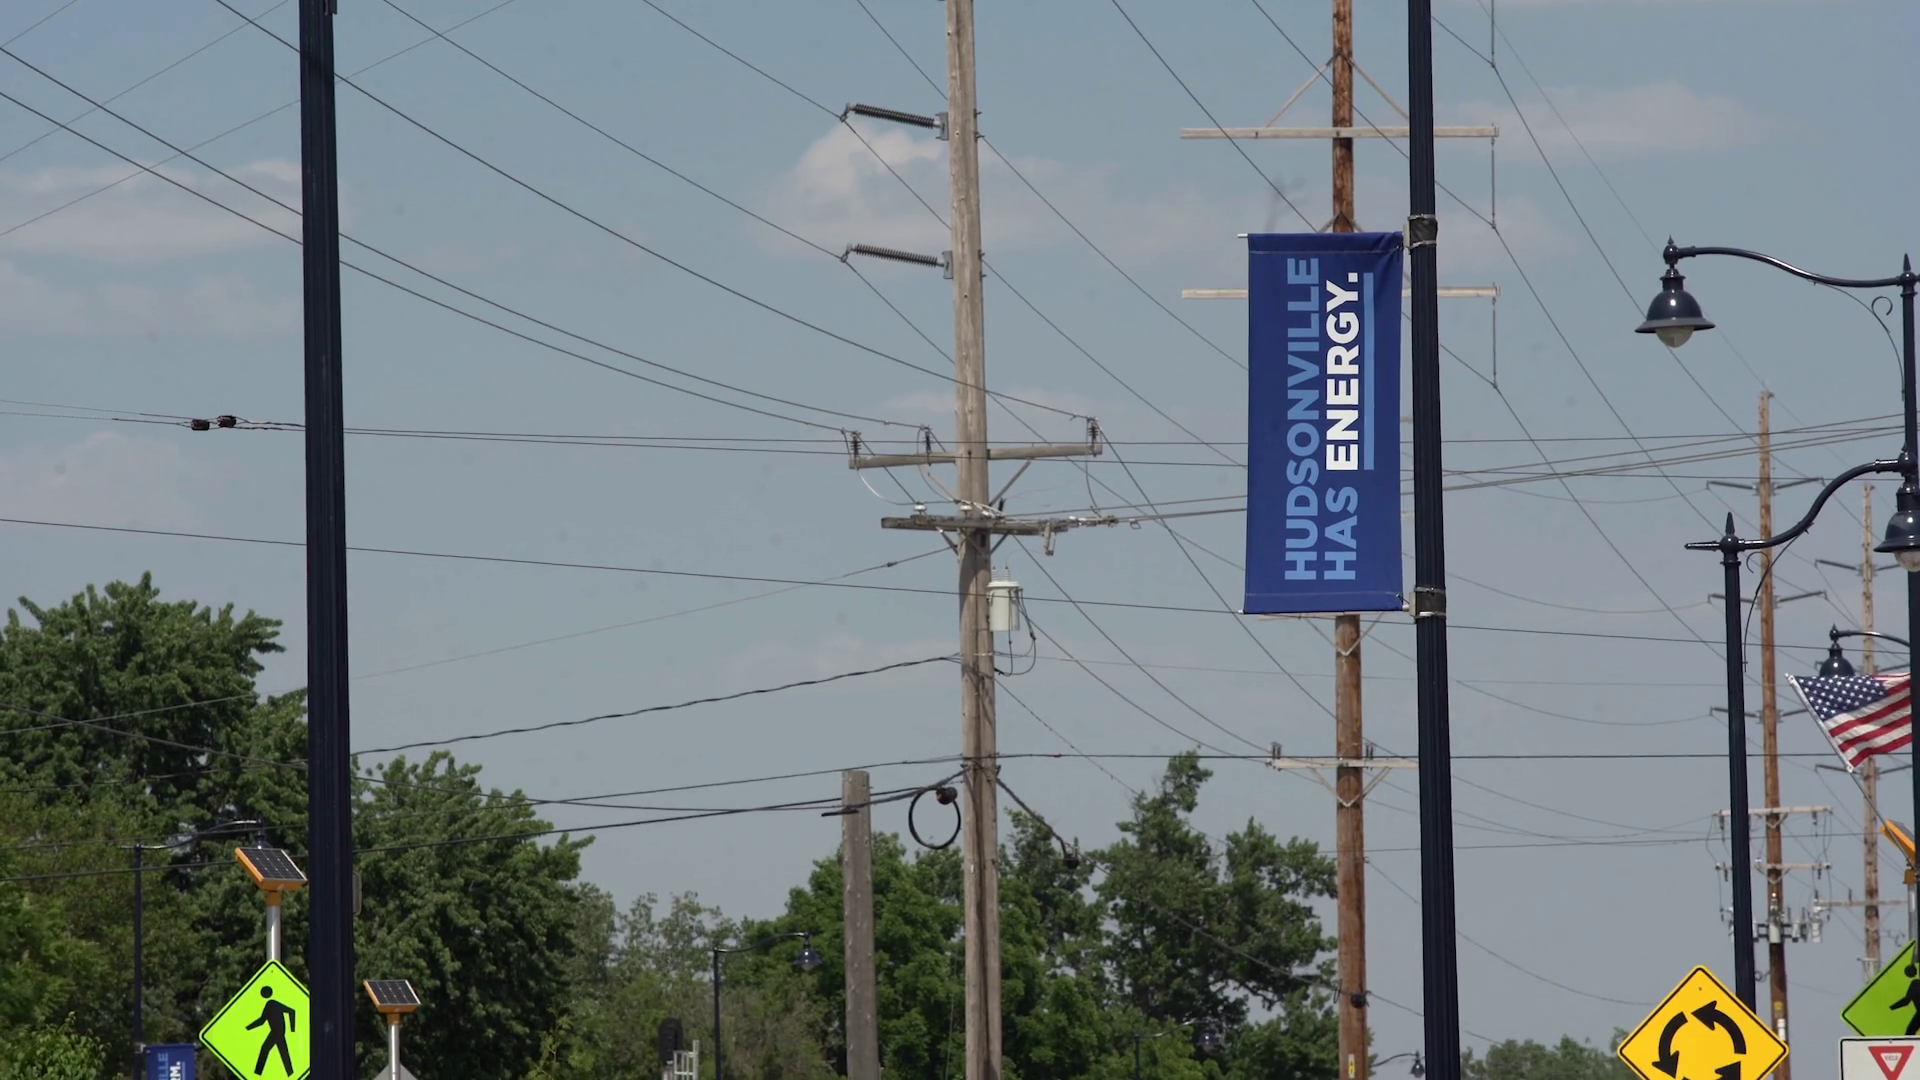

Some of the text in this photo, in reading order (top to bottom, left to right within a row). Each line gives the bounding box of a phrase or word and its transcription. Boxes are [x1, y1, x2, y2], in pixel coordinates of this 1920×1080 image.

[1284, 258, 1319, 580] HUDSONVILLE
[1324, 272, 1359, 580] HAS ENERGY.
